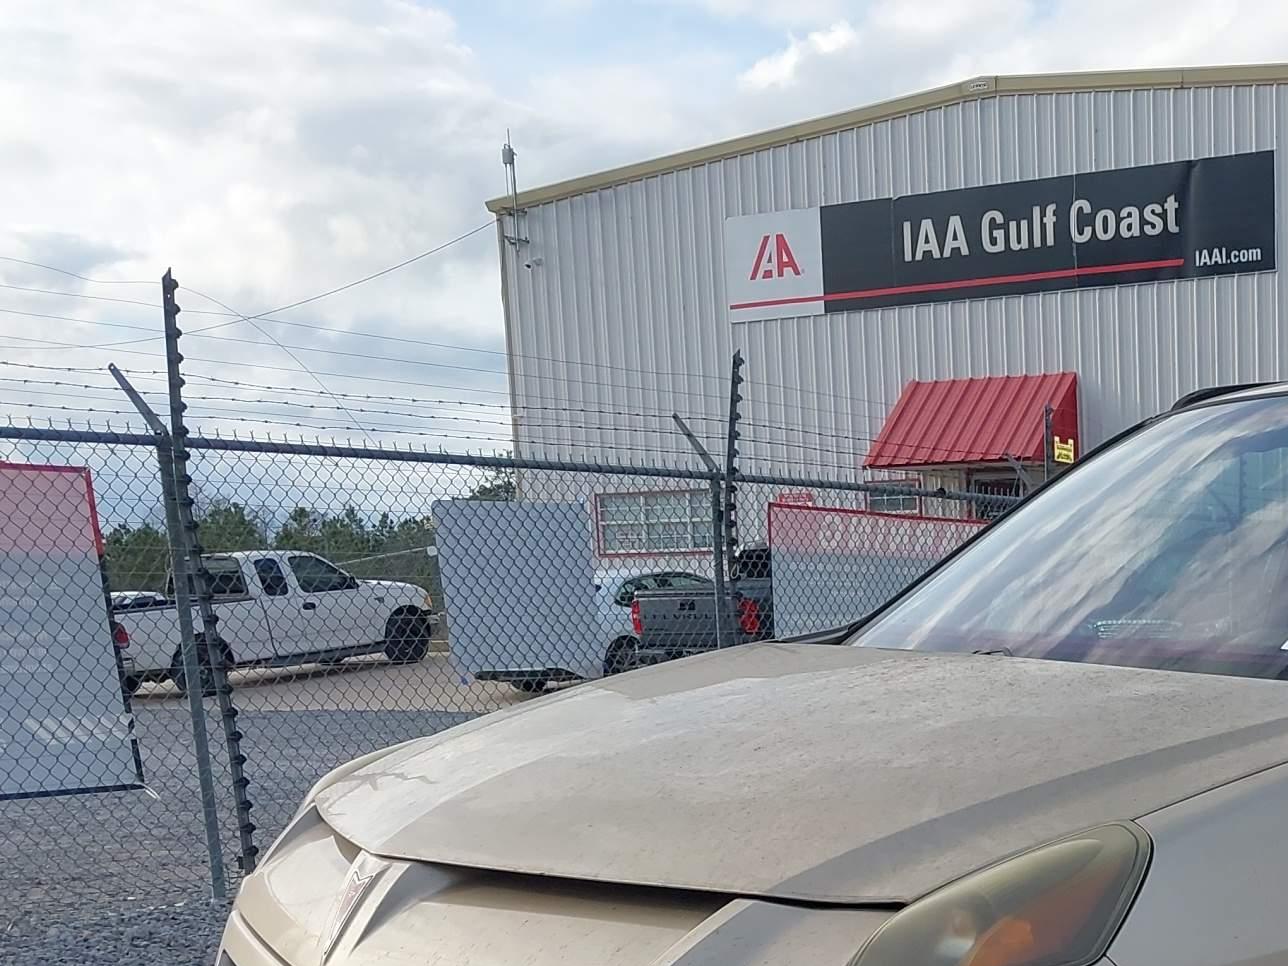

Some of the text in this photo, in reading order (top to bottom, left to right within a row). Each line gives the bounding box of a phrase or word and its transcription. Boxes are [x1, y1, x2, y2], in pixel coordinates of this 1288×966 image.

[903, 193, 1180, 262] IAA Gulf Coast
[1195, 247, 1262, 267] IAAI.com
